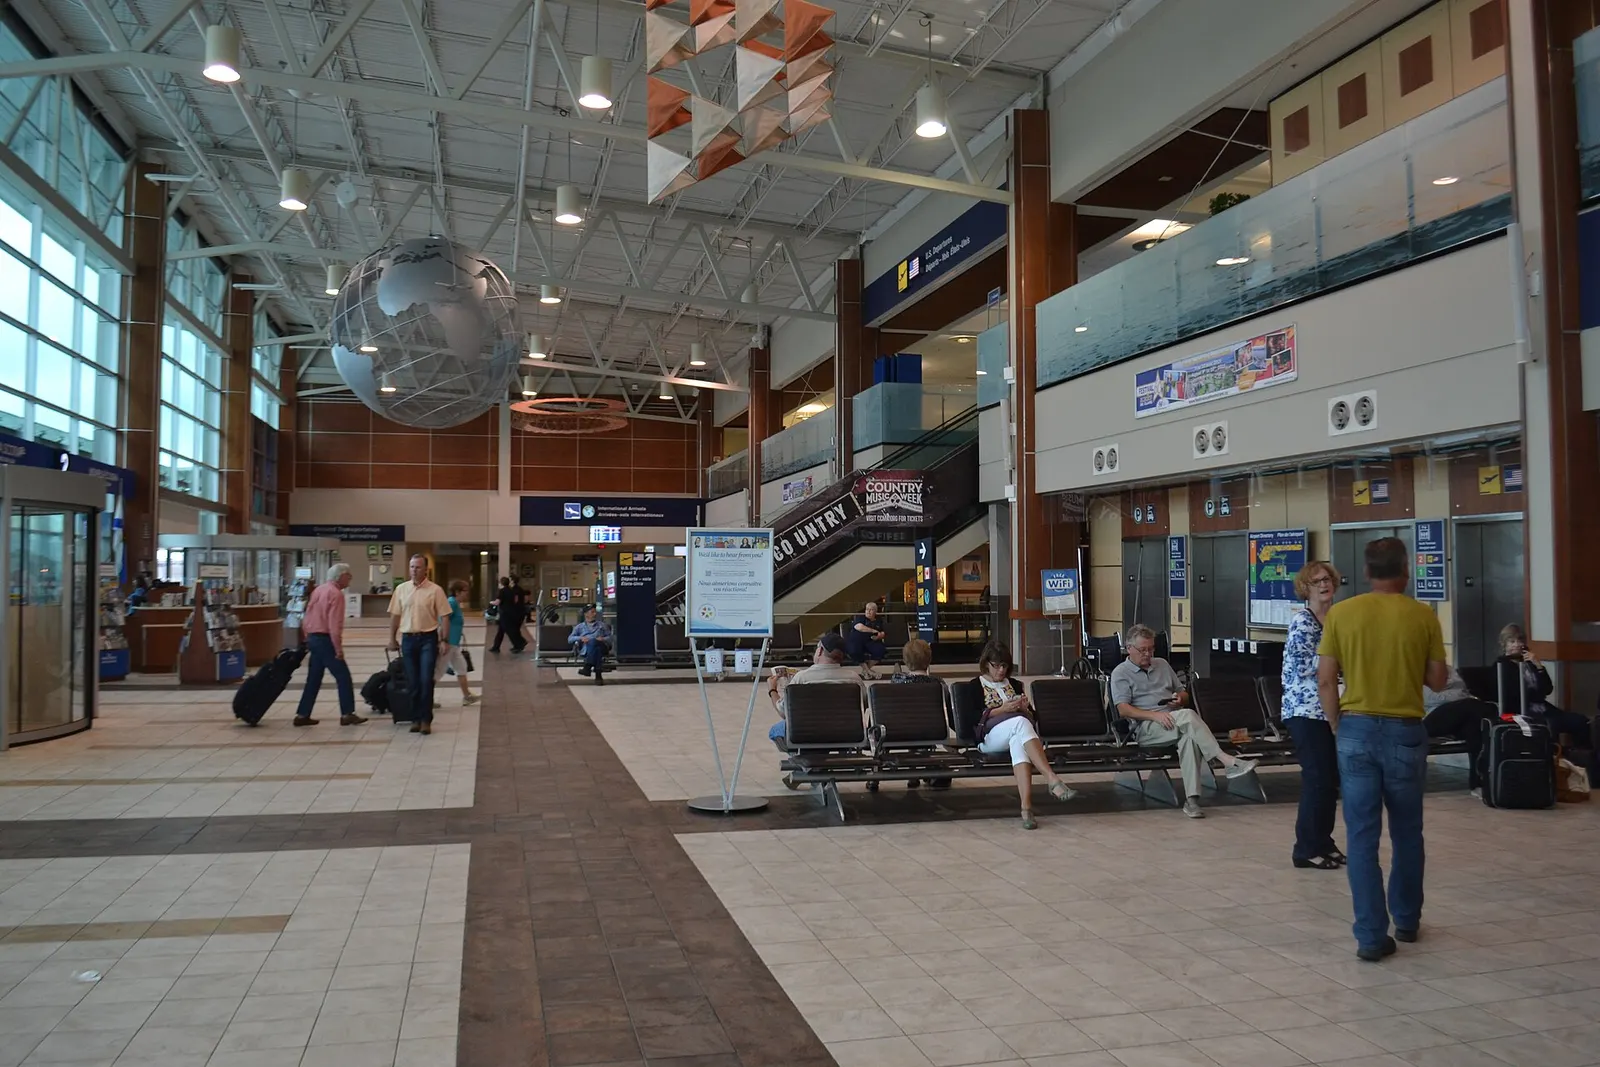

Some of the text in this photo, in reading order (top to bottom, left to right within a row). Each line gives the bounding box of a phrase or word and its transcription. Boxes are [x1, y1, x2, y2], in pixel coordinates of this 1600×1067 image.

[932, 236, 952, 254] Departures
[866, 482, 923, 493] COUNTRY
[866, 492, 923, 504] MUSIC WEEK
[1048, 580, 1071, 588] WiFi
